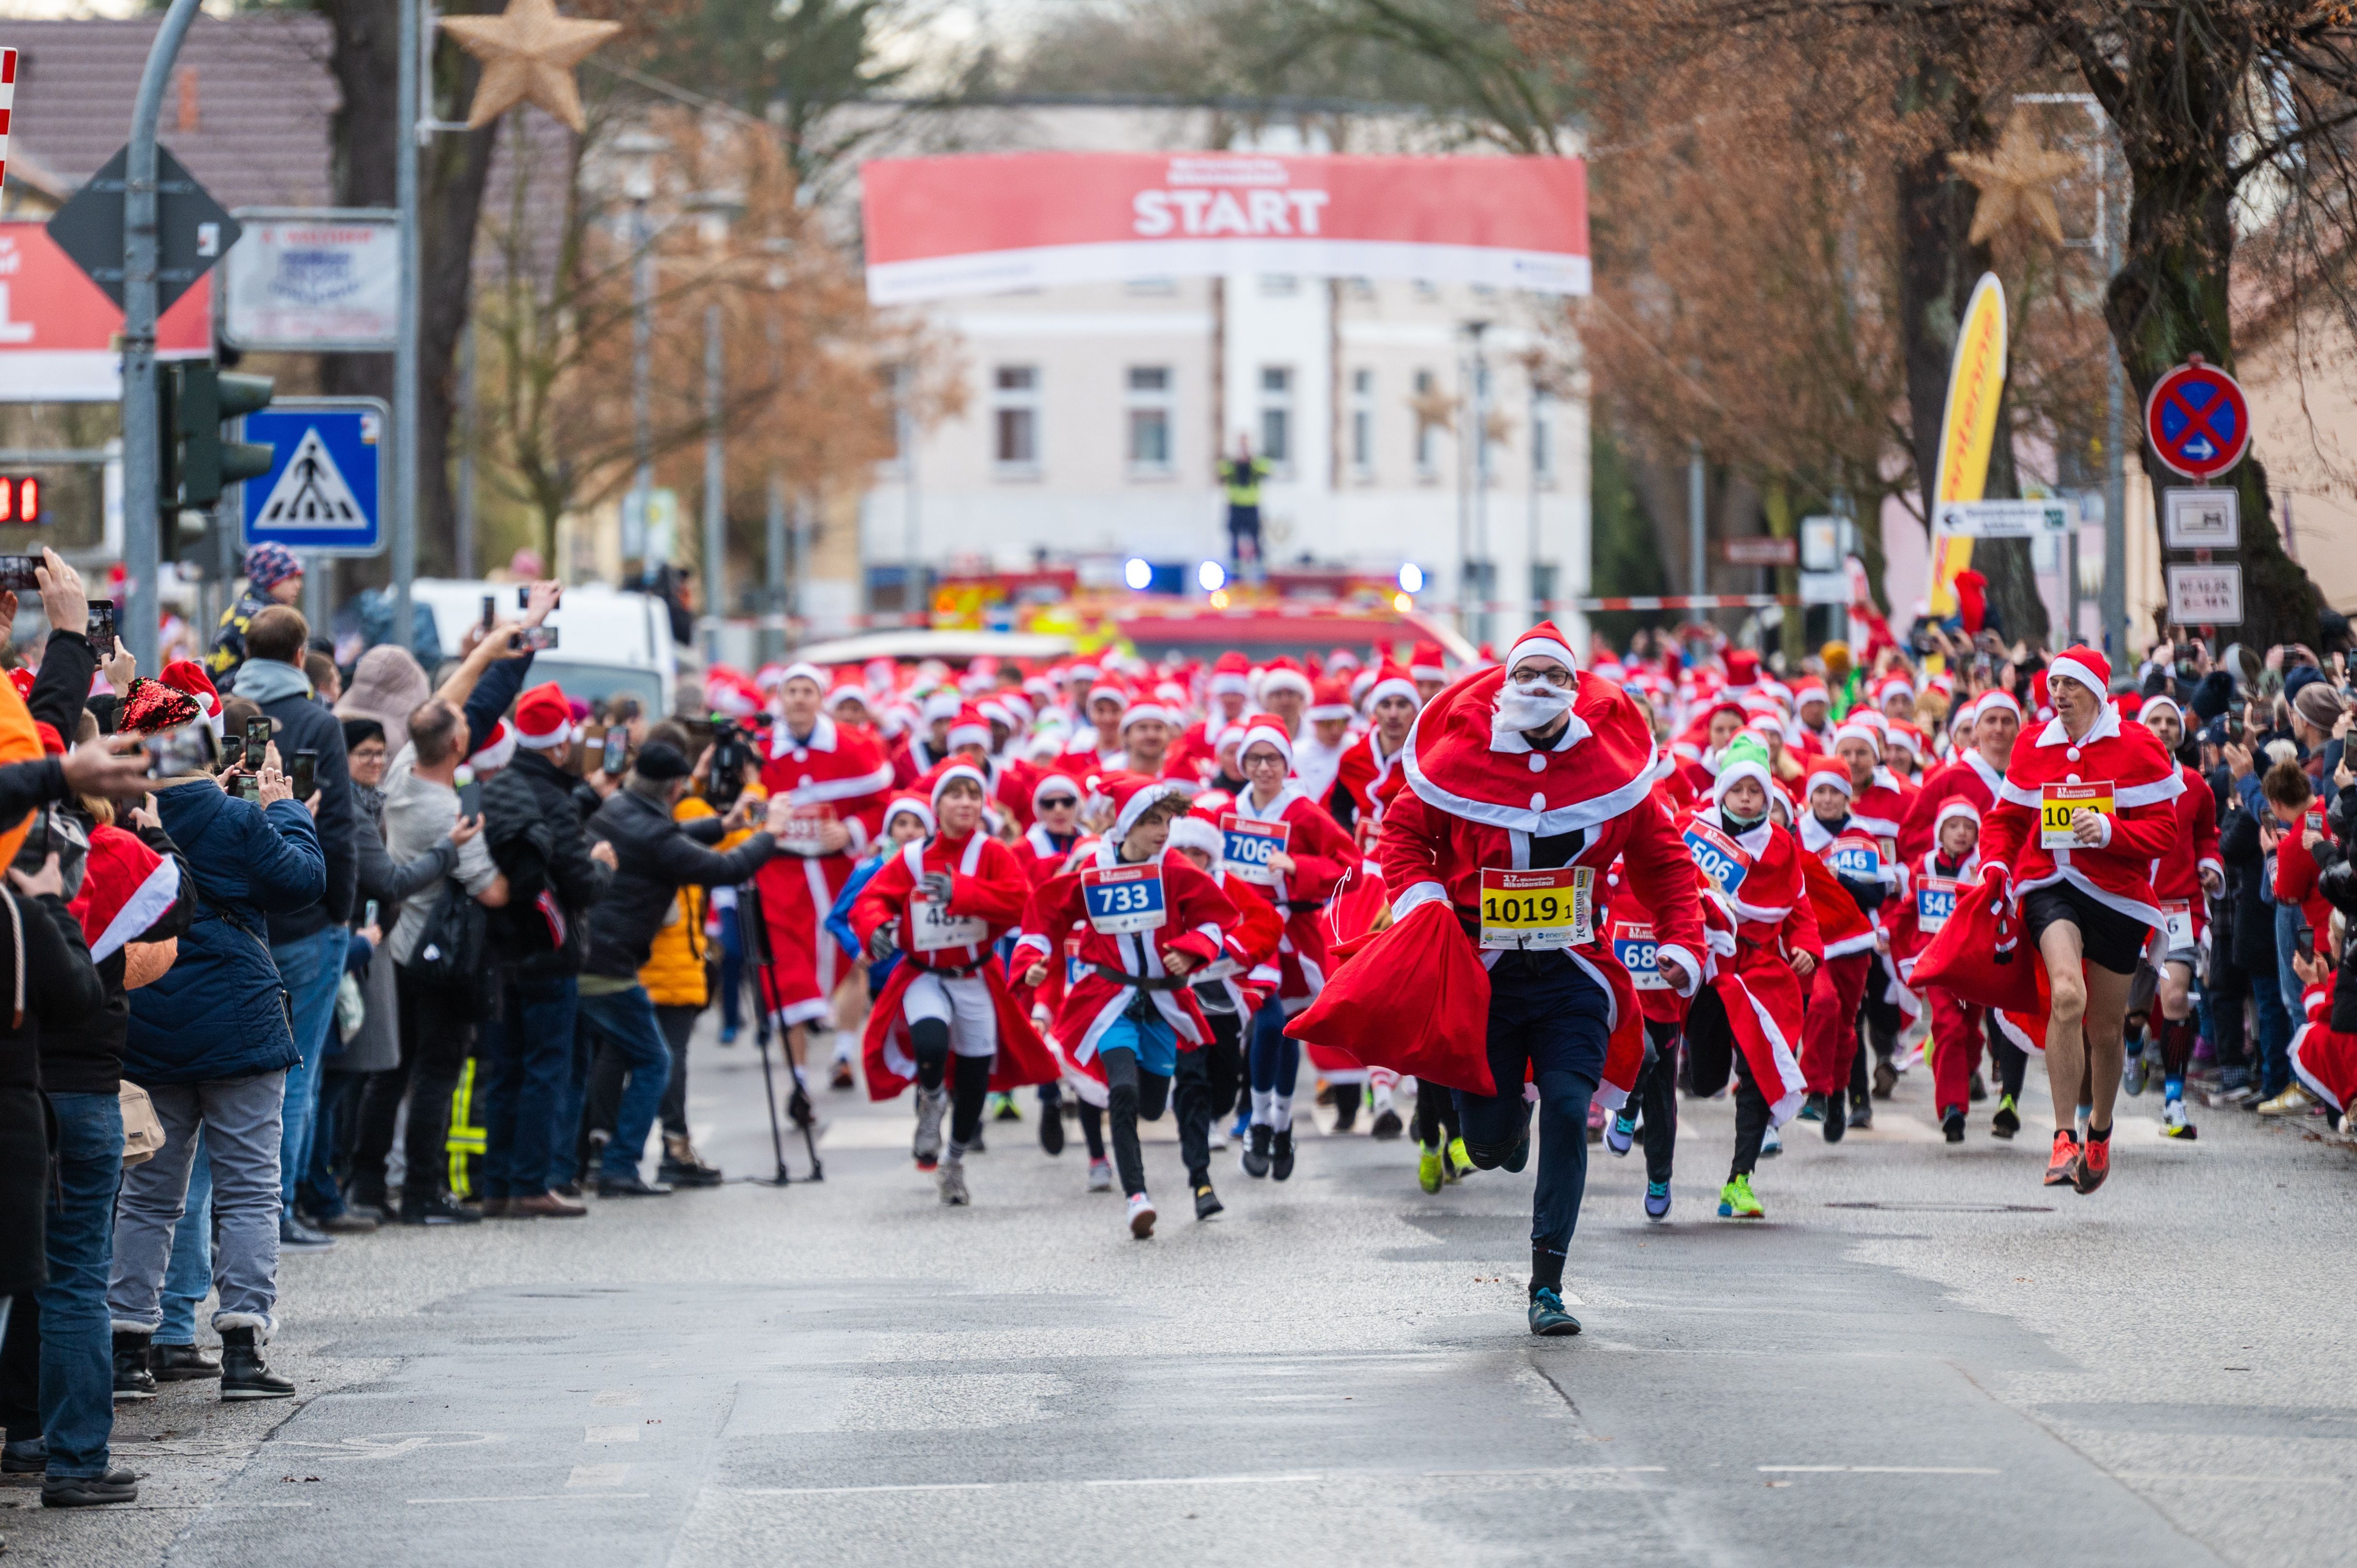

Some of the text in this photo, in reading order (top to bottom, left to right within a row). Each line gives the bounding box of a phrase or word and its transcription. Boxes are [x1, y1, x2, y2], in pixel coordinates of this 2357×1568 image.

[1133, 190, 1329, 237] START
[2044, 805, 2100, 826] 10
[1230, 835, 1272, 864] 706
[1692, 840, 1734, 883] 506
[1097, 884, 1149, 912] 733
[1485, 896, 1572, 923] 1019 1
[926, 907, 971, 927] 48
